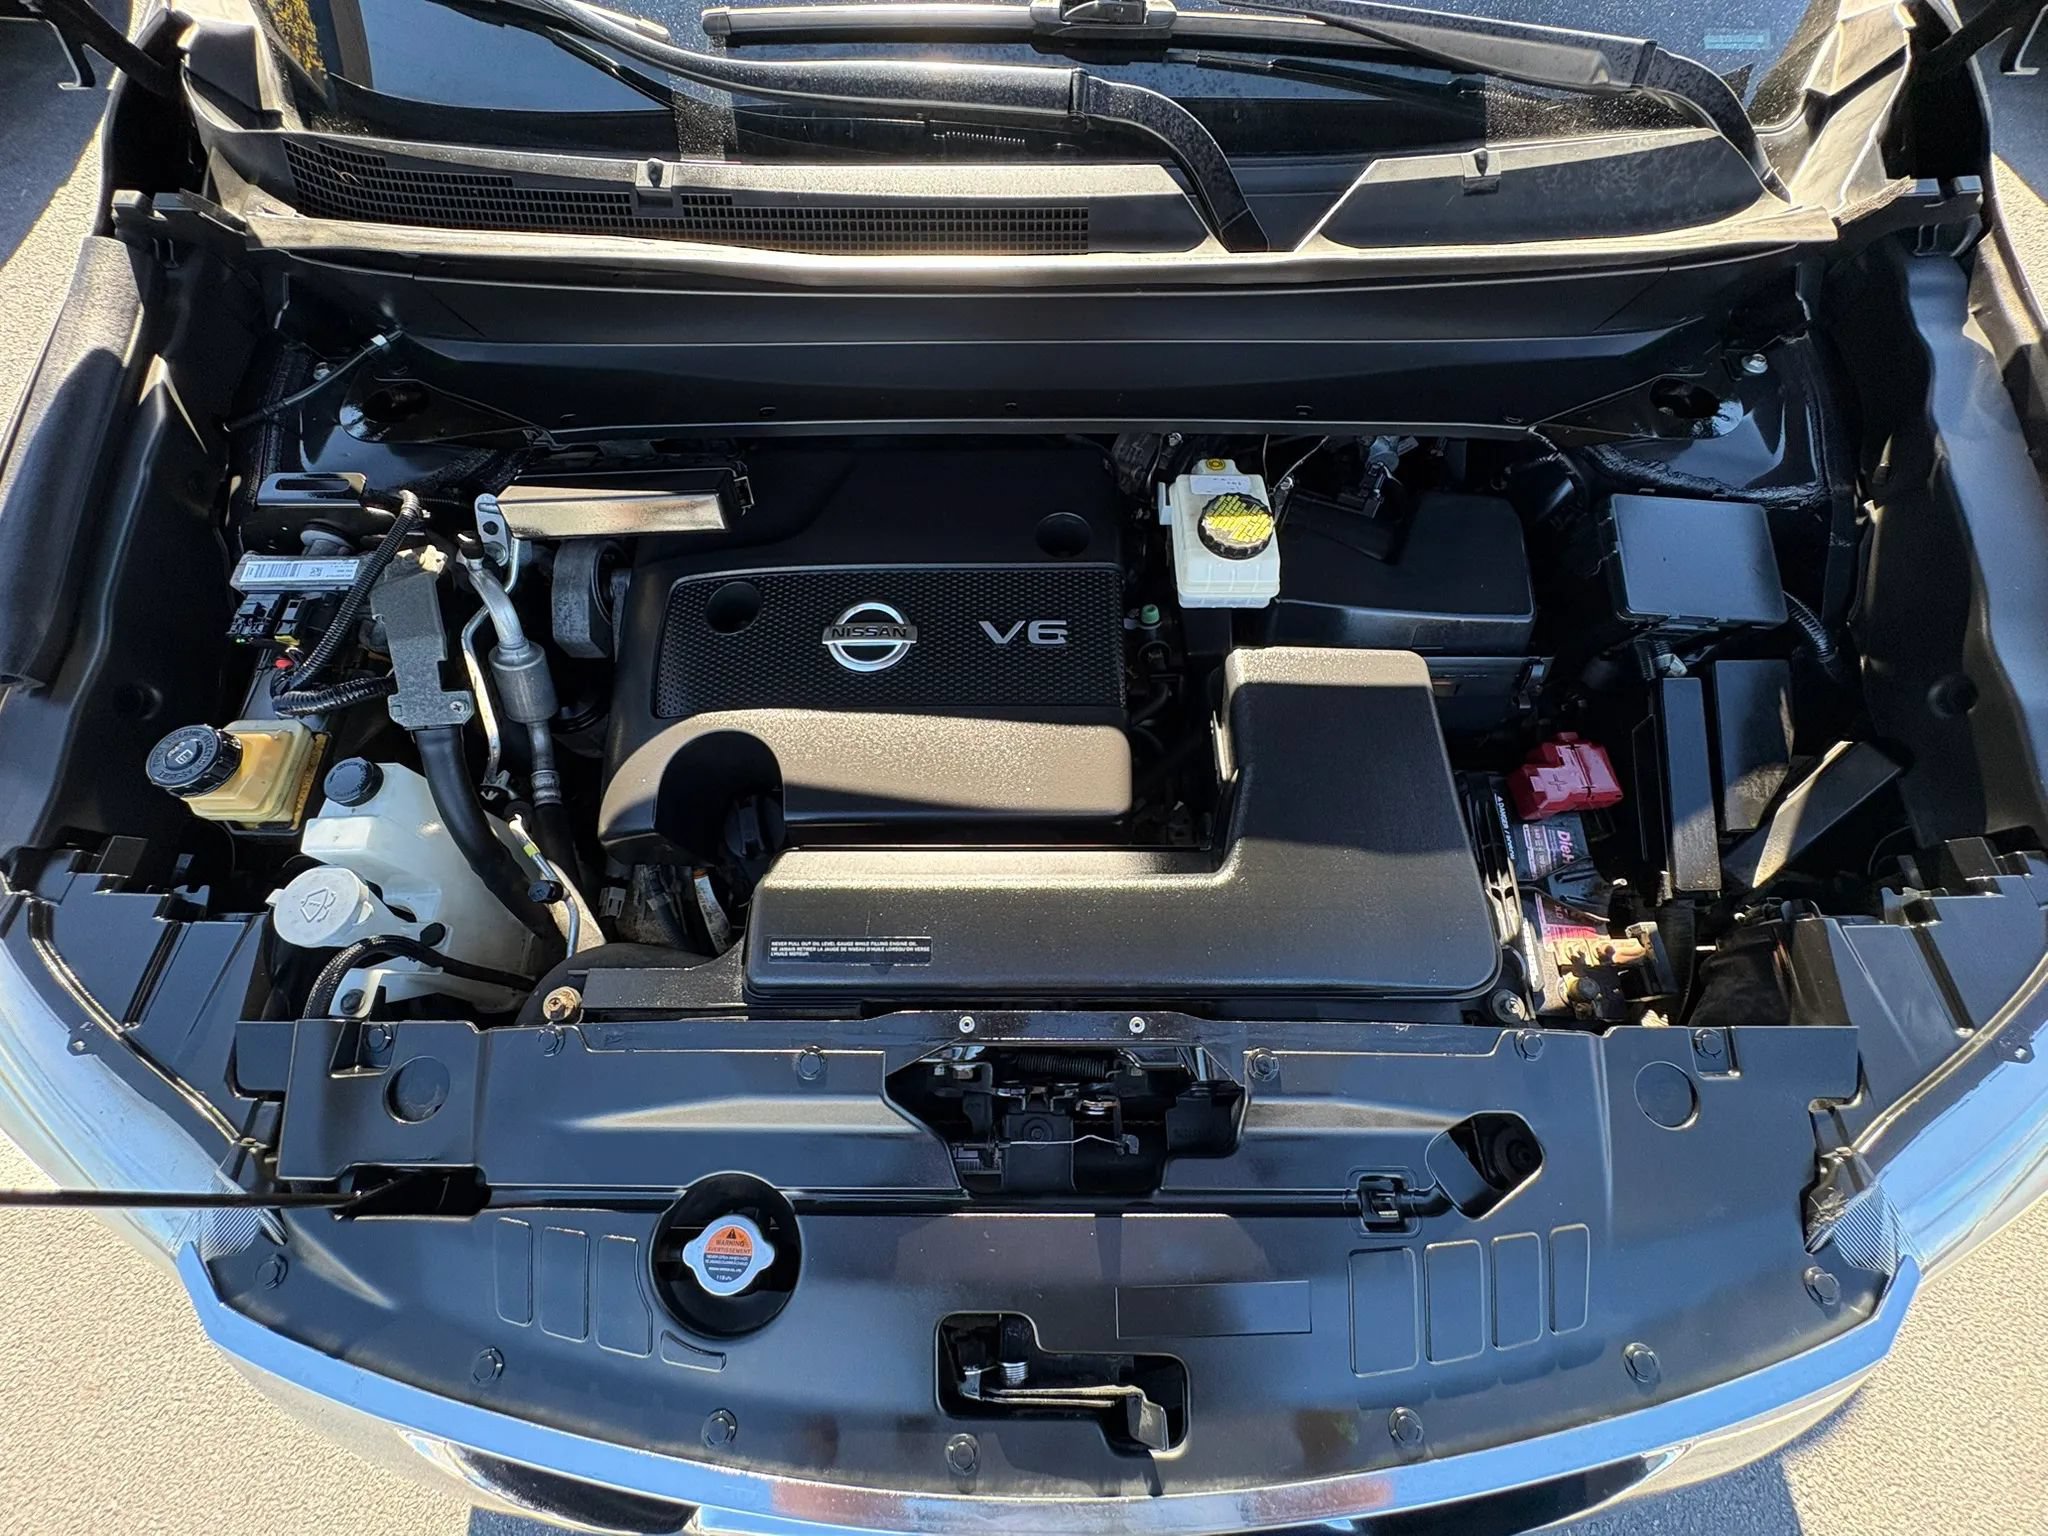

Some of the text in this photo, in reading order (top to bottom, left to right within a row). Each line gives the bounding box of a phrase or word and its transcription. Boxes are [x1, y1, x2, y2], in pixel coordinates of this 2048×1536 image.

[831, 624, 907, 638] NISSAN
[979, 620, 1069, 645] V6
[1498, 802, 1509, 830] DANGER
